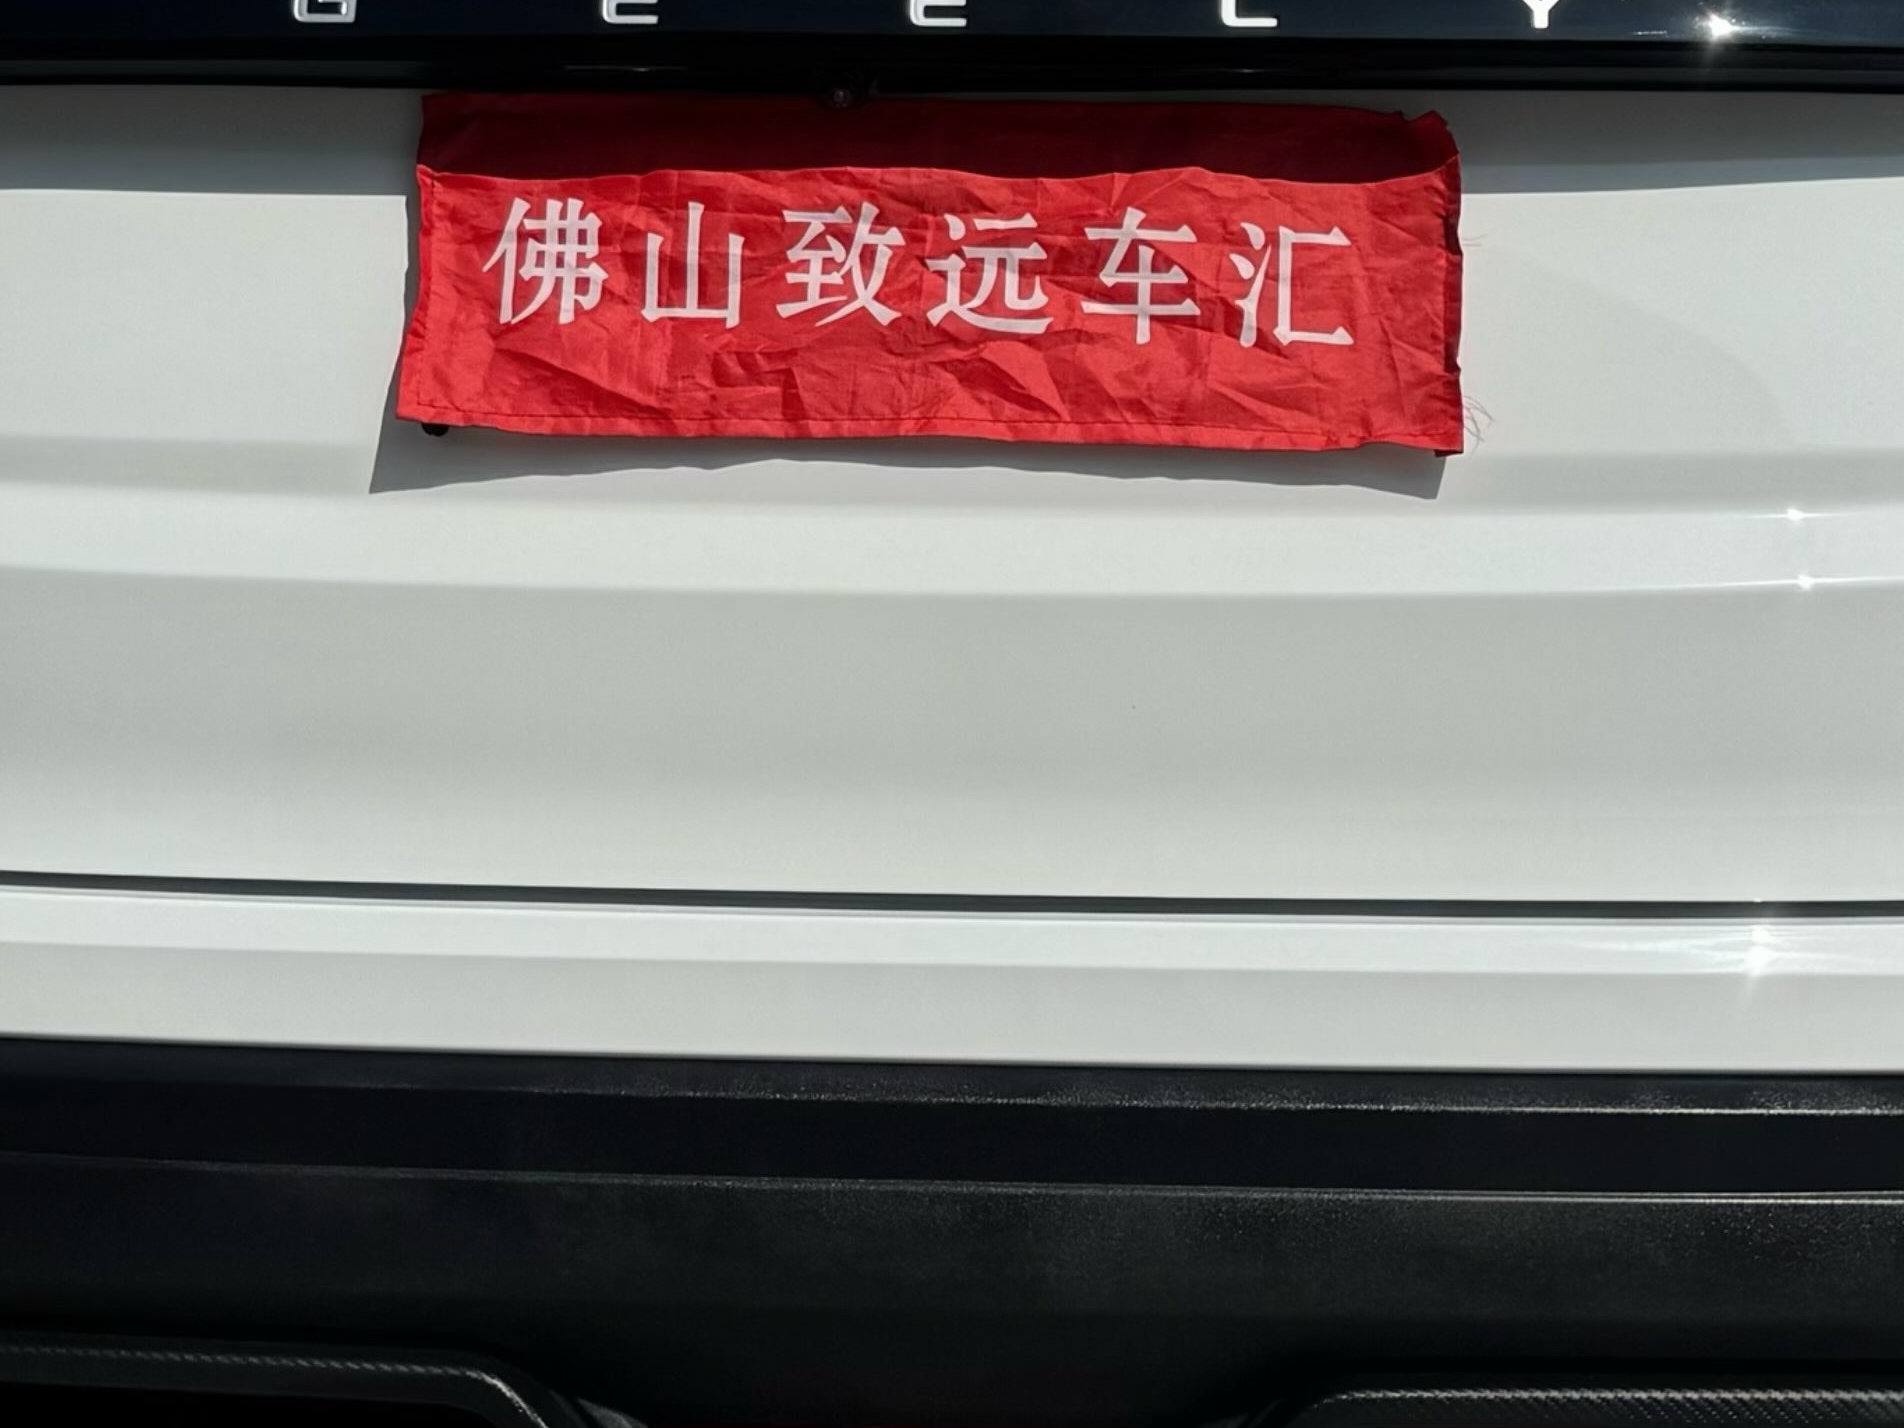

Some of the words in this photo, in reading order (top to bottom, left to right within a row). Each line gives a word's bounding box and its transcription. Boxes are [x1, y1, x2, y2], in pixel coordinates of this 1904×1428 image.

[483, 197, 1354, 348] 佛山致远车汇
